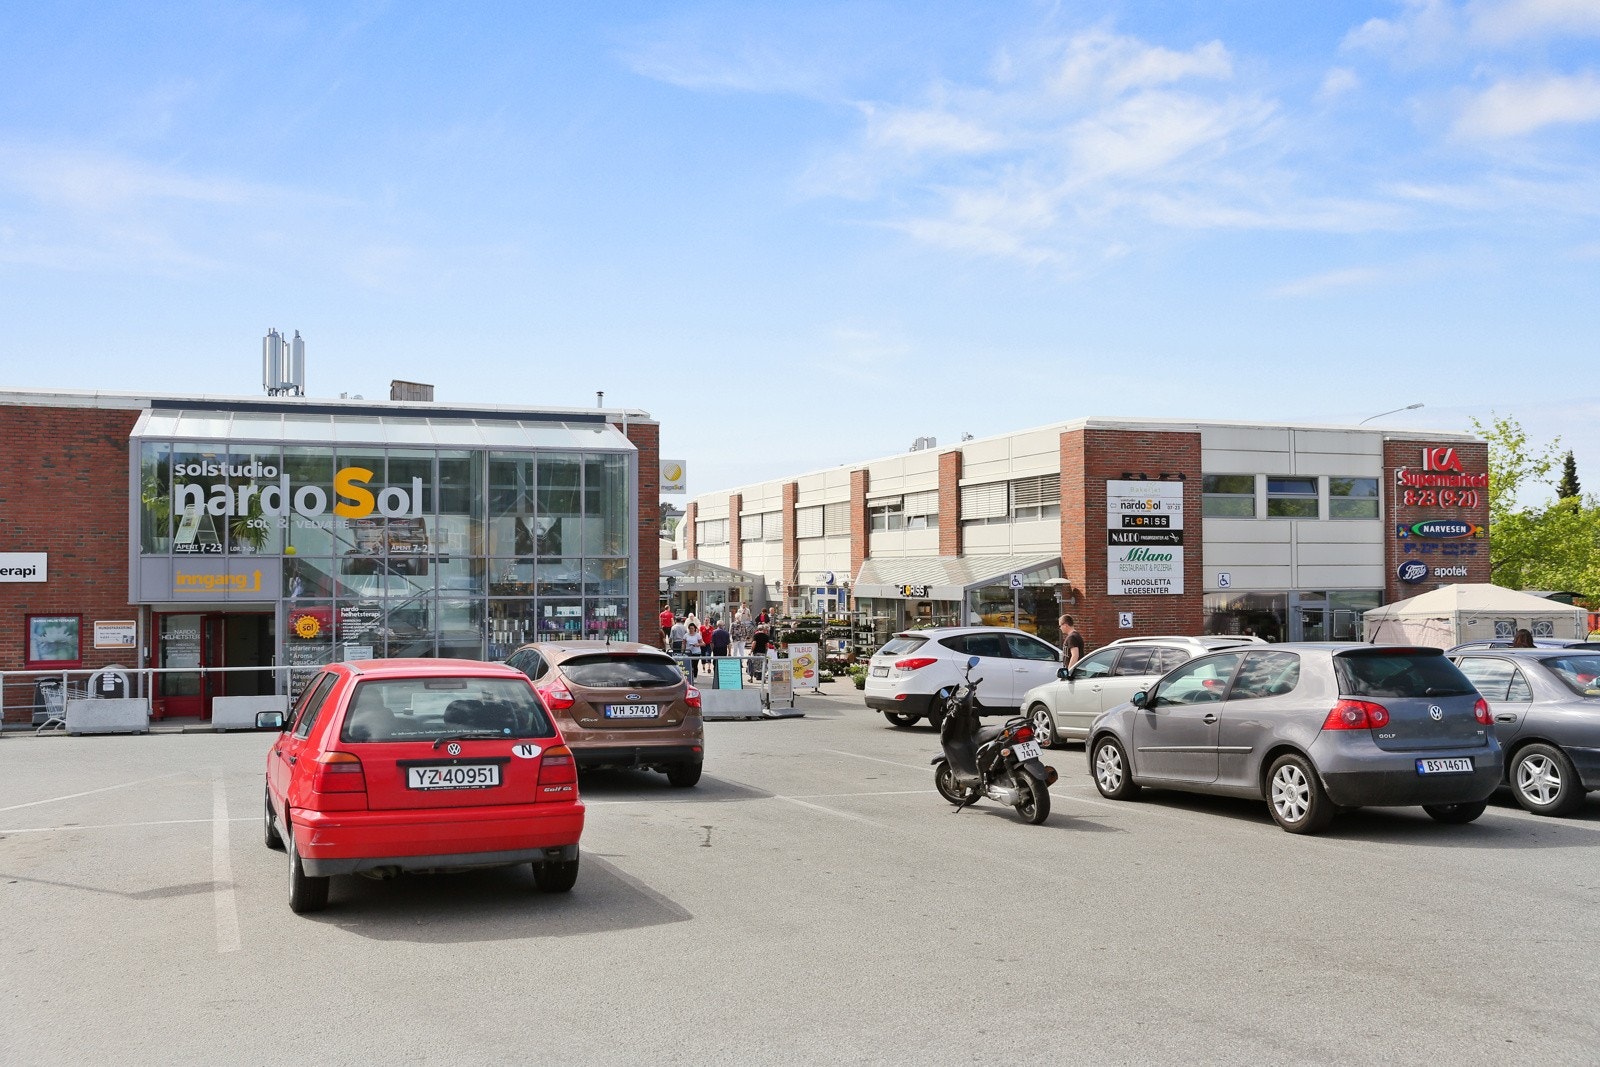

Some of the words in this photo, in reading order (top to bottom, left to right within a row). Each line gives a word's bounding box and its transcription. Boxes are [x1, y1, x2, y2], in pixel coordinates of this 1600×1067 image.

[1423, 448, 1464, 471] ICA
[175, 460, 278, 478] solstudio
[174, 467, 423, 520] nardoSol
[1121, 499, 1161, 510] nardoSol
[1124, 517, 1167, 525] FLORISS
[1423, 525, 1467, 533] NARVESEN
[1112, 532, 1140, 543] NARDO
[200, 543, 223, 552] 7-23
[1120, 547, 1173, 561] Milano
[0, 565, 36, 578] erapi
[1119, 563, 1148, 571] RESTAURANT
[1434, 566, 1468, 578] apotek
[176, 571, 248, 589] inngang
[1121, 578, 1171, 586] NARDOSLETTA
[612, 706, 625, 715] VH
[629, 706, 656, 715] 57403
[521, 744, 533, 756] N
[1021, 742, 1030, 750] FP
[1427, 760, 1440, 771] BS
[1443, 760, 1470, 770] 14671
[415, 769, 439, 785] YZ
[443, 767, 493, 784] 40951
